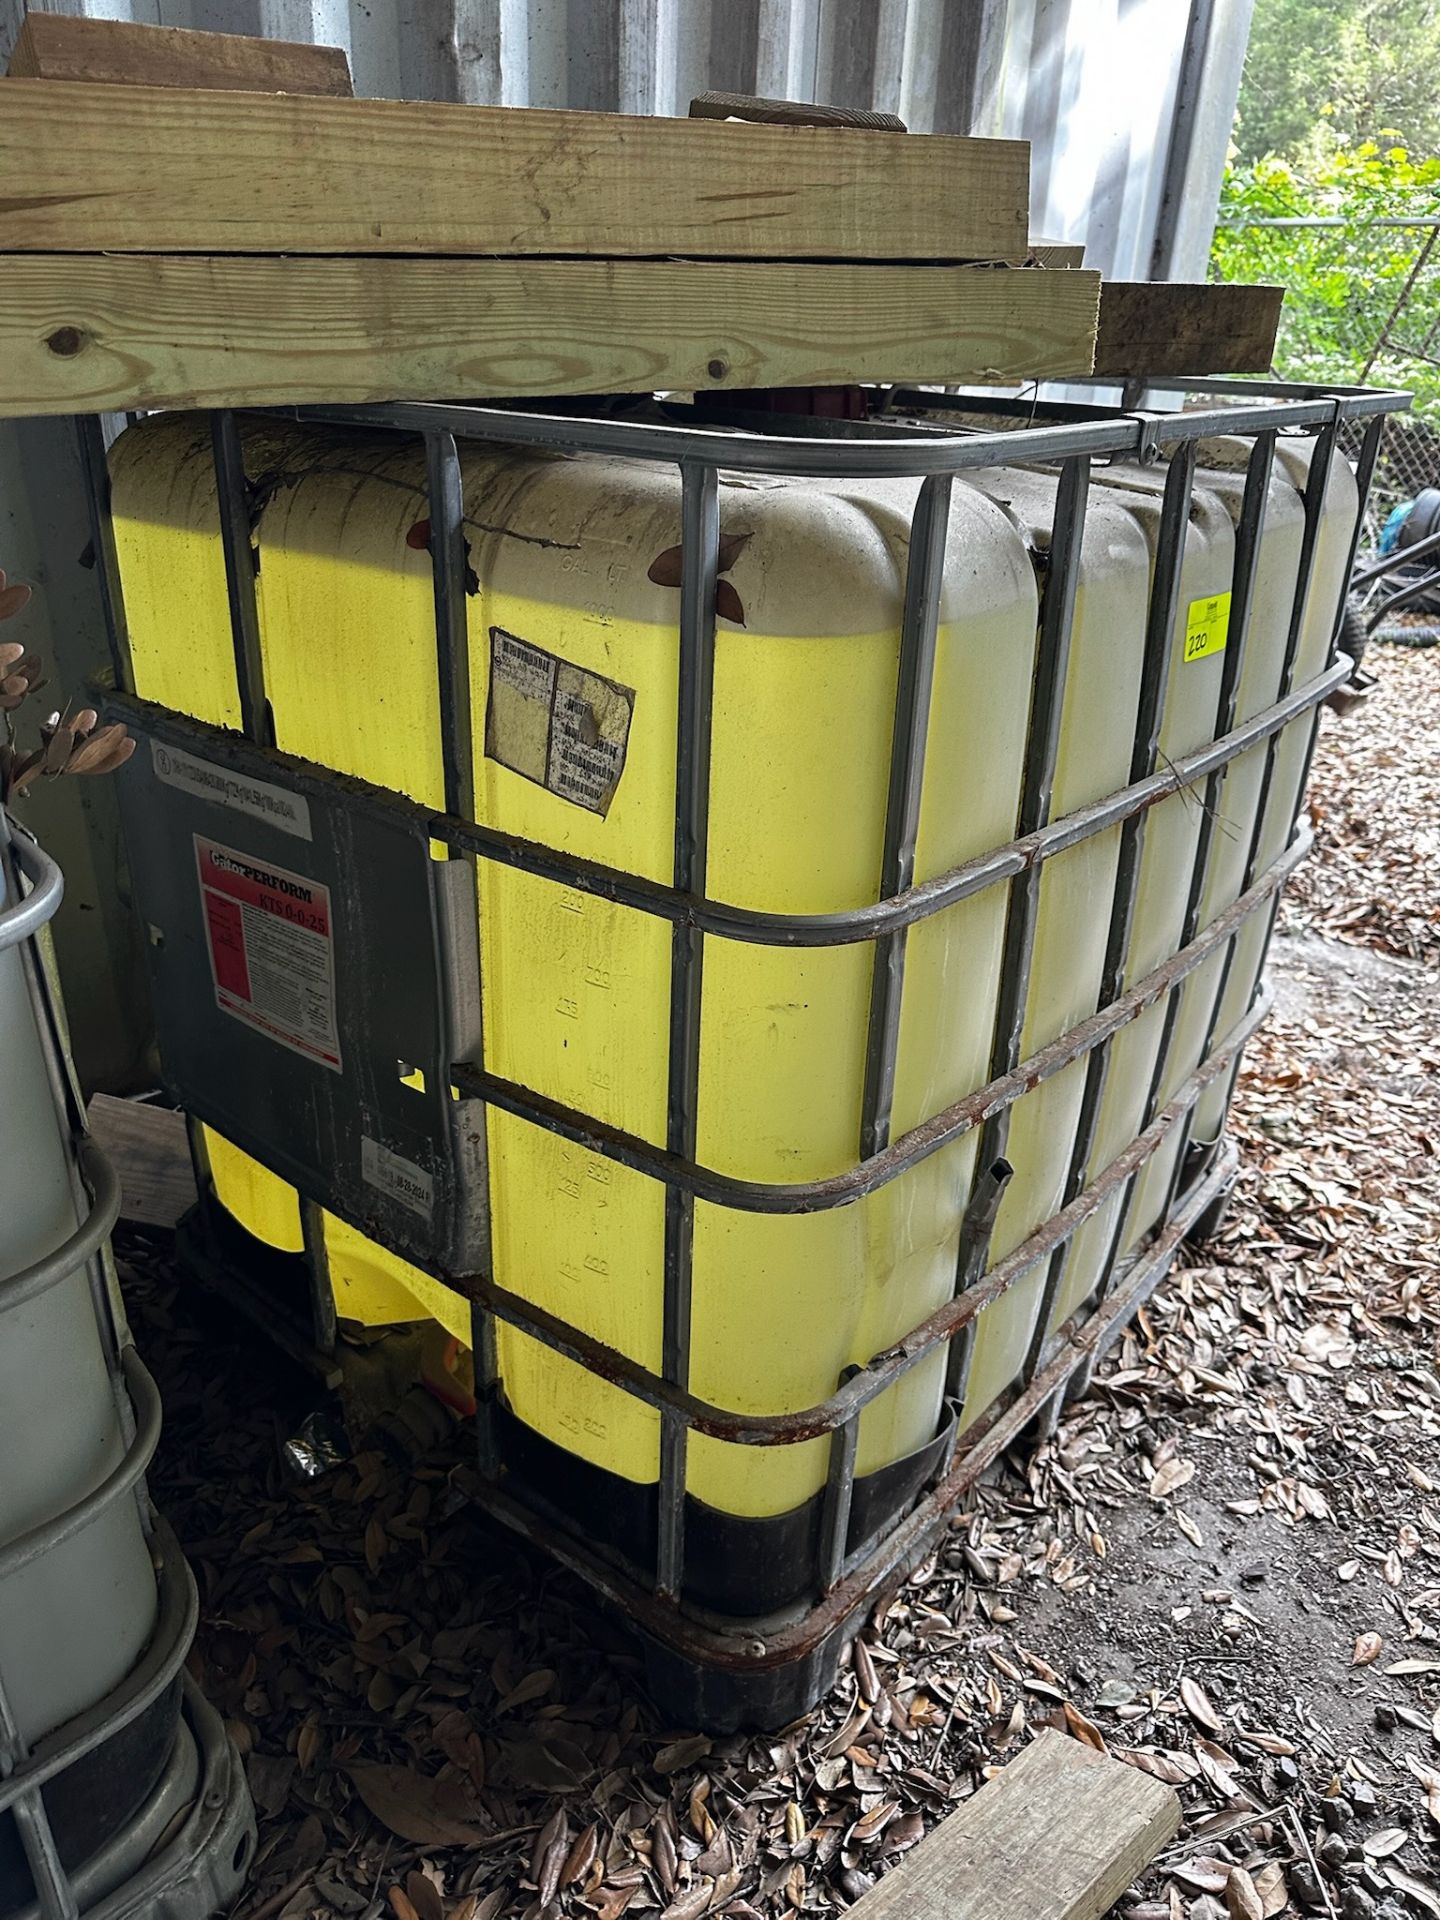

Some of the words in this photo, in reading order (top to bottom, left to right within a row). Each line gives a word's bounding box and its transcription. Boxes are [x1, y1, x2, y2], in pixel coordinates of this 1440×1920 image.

[1188, 632, 1208, 656] 220
[562, 890, 585, 909] 200
[259, 894, 282, 915] KTS
[285, 903, 325, 933] 0-0-25
